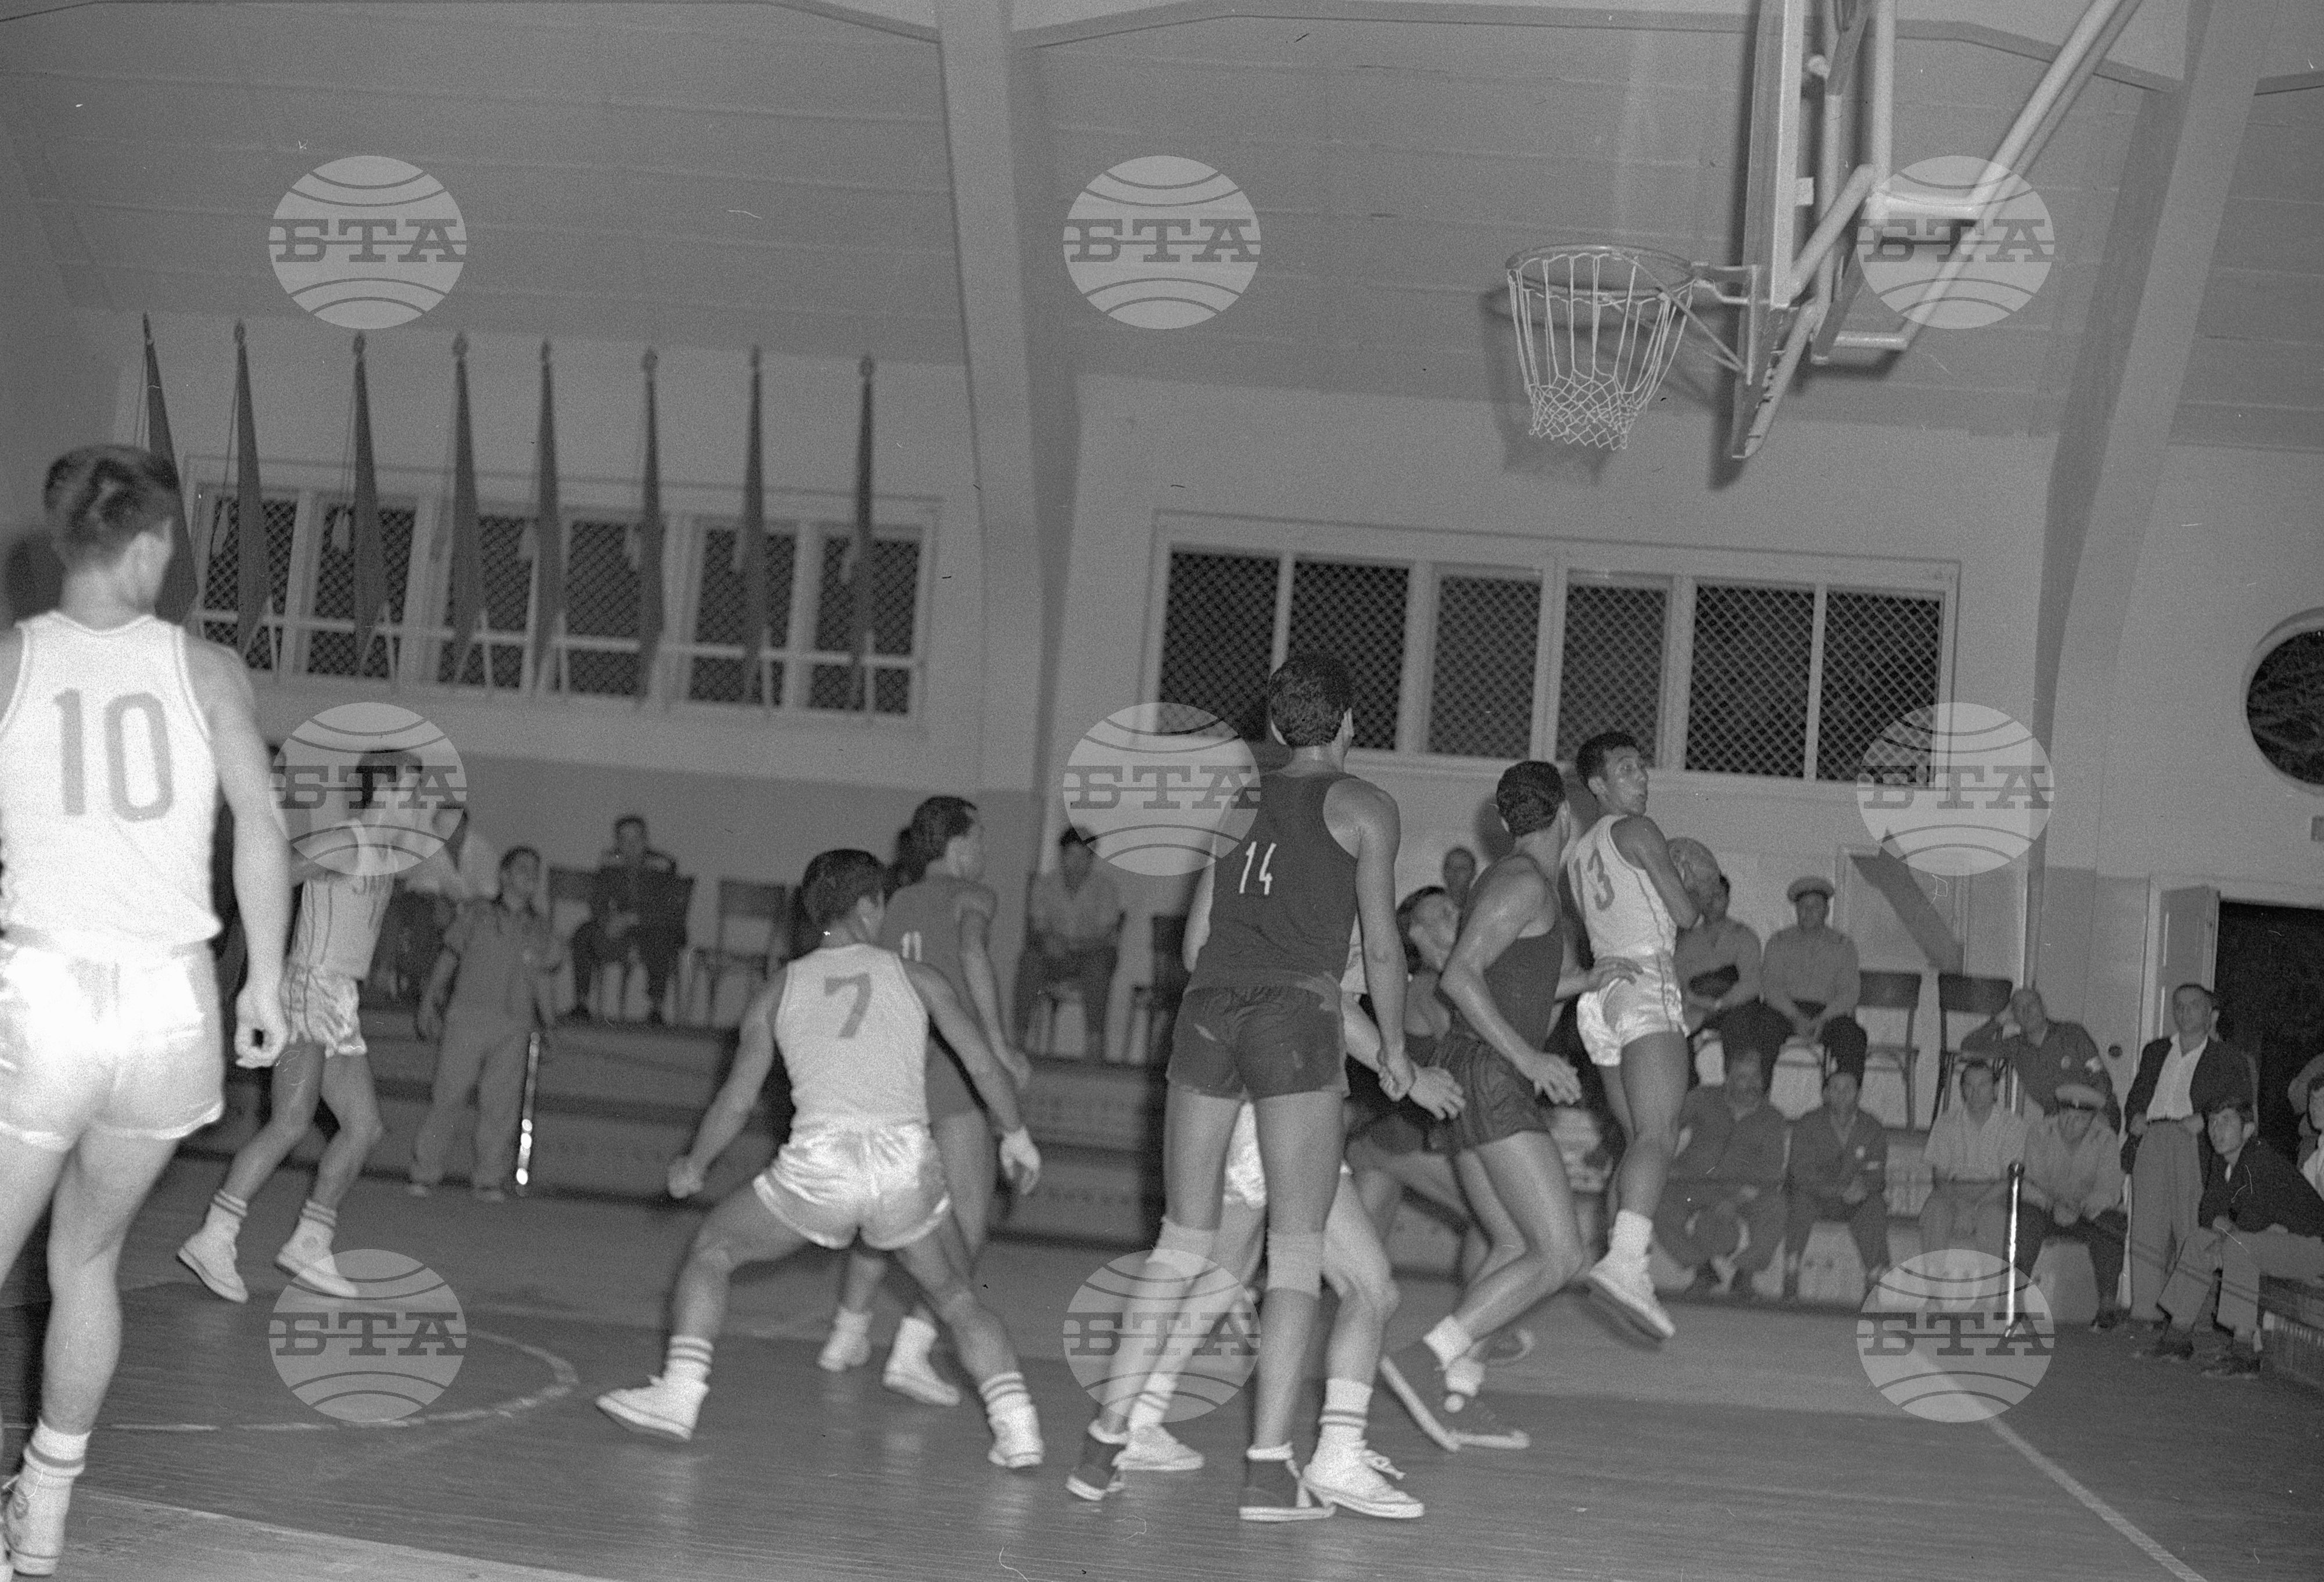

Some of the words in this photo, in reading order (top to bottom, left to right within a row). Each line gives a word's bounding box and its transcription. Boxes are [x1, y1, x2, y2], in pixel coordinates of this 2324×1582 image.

[53, 688, 174, 823] 10
[1239, 841, 1277, 895] 14
[1573, 848, 1615, 917] 13
[824, 973, 871, 1039] 7
